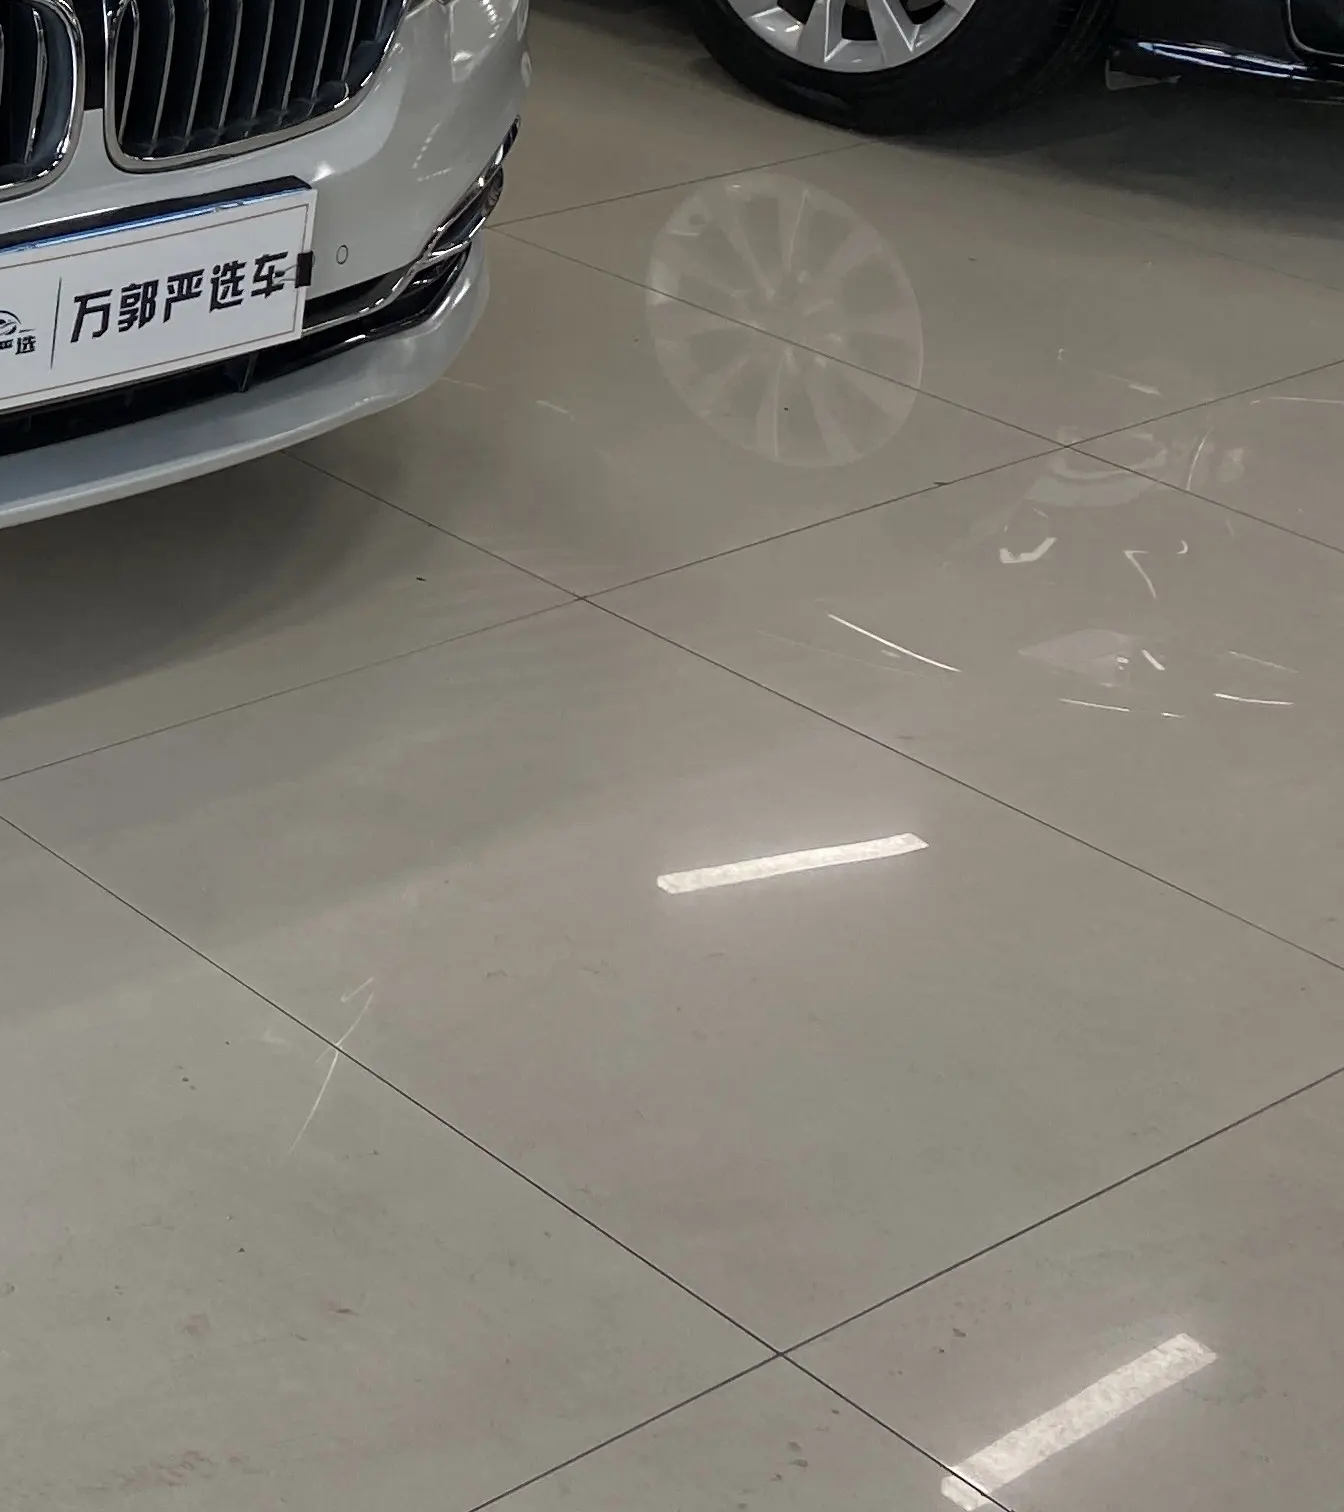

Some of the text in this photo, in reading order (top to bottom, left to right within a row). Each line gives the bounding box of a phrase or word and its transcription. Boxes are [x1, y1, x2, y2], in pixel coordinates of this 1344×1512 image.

[70, 251, 289, 344] 万郭严选车
